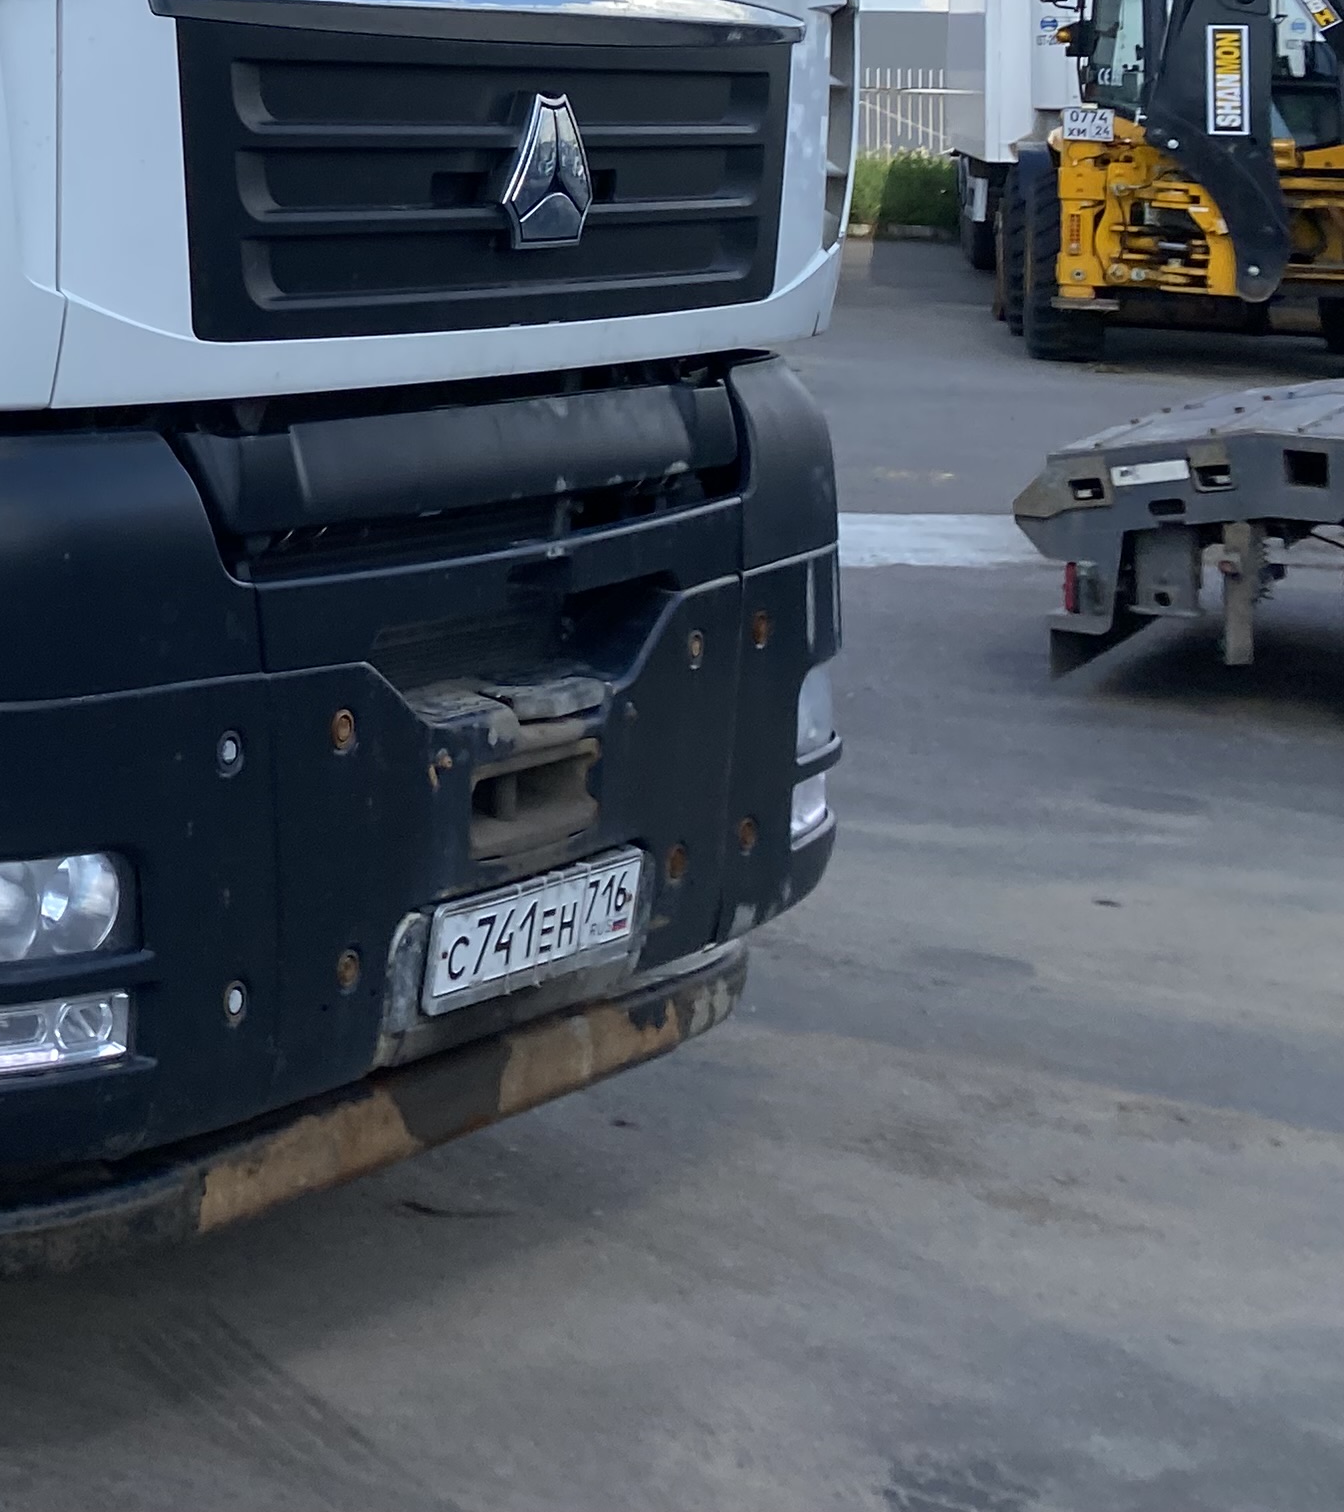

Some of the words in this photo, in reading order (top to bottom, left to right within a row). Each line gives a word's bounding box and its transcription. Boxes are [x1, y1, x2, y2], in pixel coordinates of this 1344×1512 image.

[1214, 32, 1243, 128] SHANMON
[1069, 110, 1109, 125] 0774
[1094, 125, 1111, 137] 24
[584, 870, 629, 925] 716
